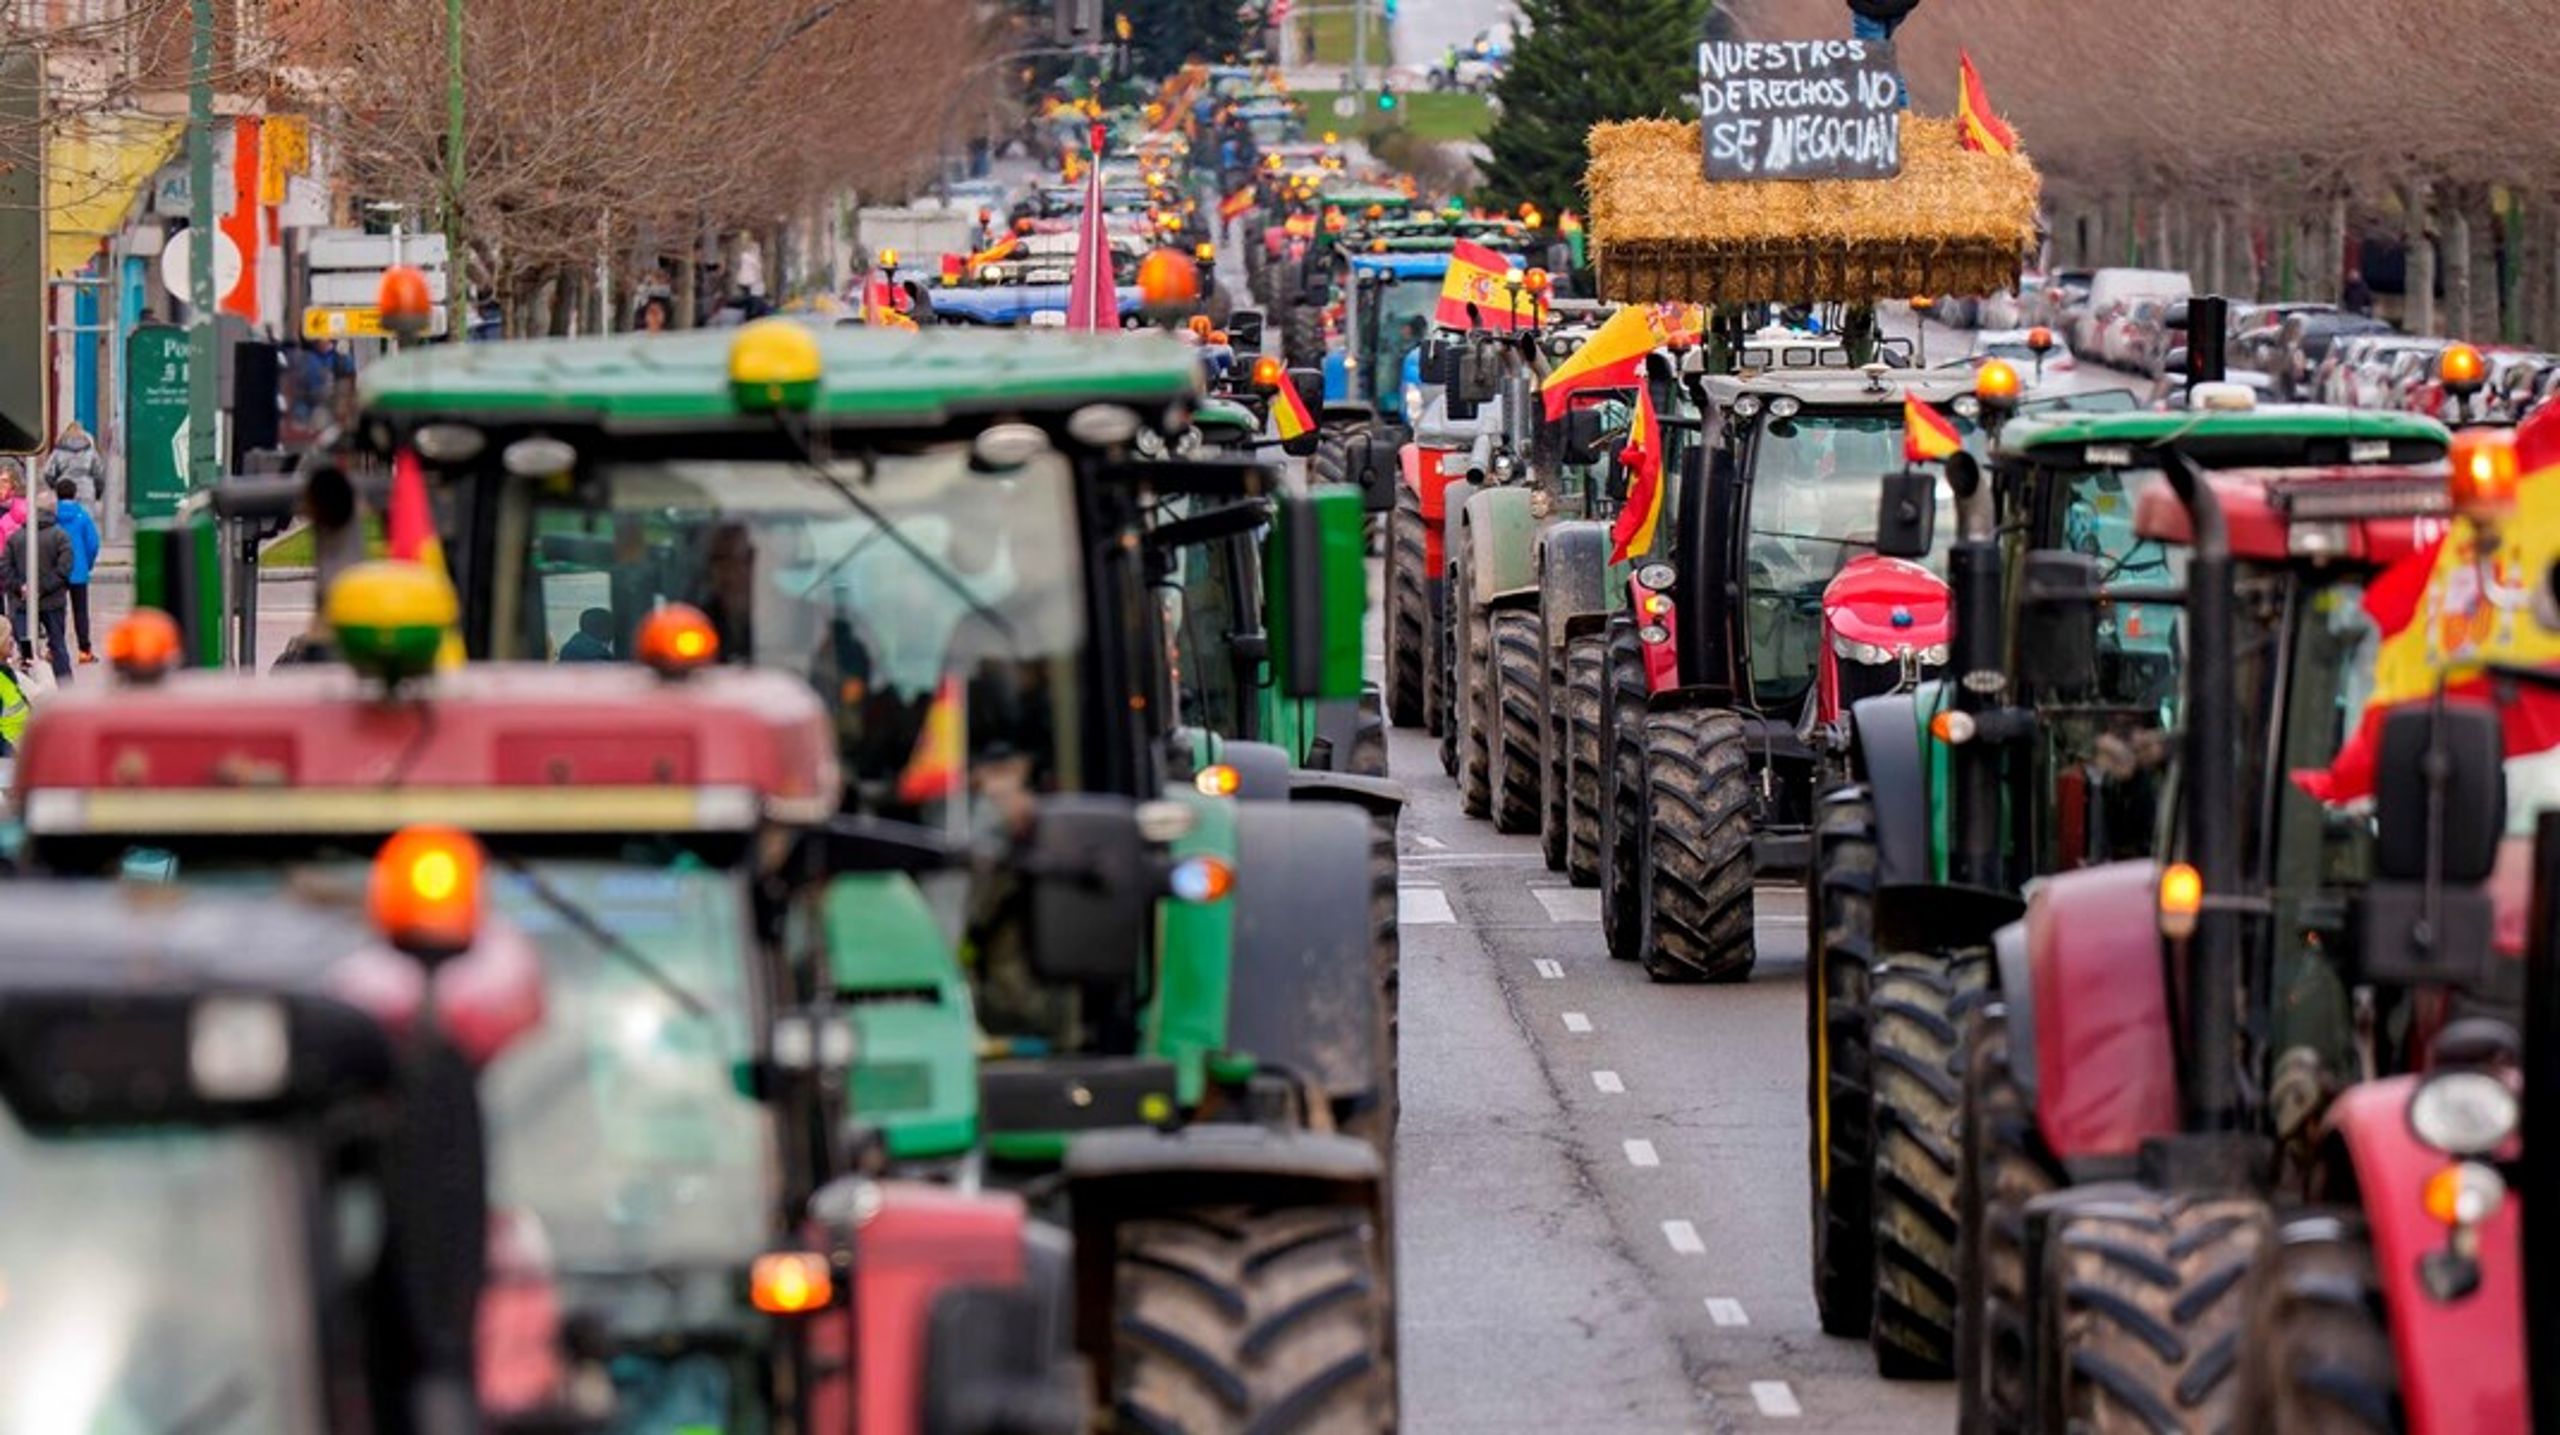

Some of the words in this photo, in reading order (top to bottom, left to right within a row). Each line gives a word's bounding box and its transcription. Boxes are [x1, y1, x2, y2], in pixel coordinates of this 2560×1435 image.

[1699, 39, 1867, 79] NUESTROS
[1701, 77, 1849, 116] DERECHOS
[1857, 69, 1897, 110] NO
[1711, 118, 1762, 172] SE
[1764, 112, 1899, 171] NEGOCIAN
